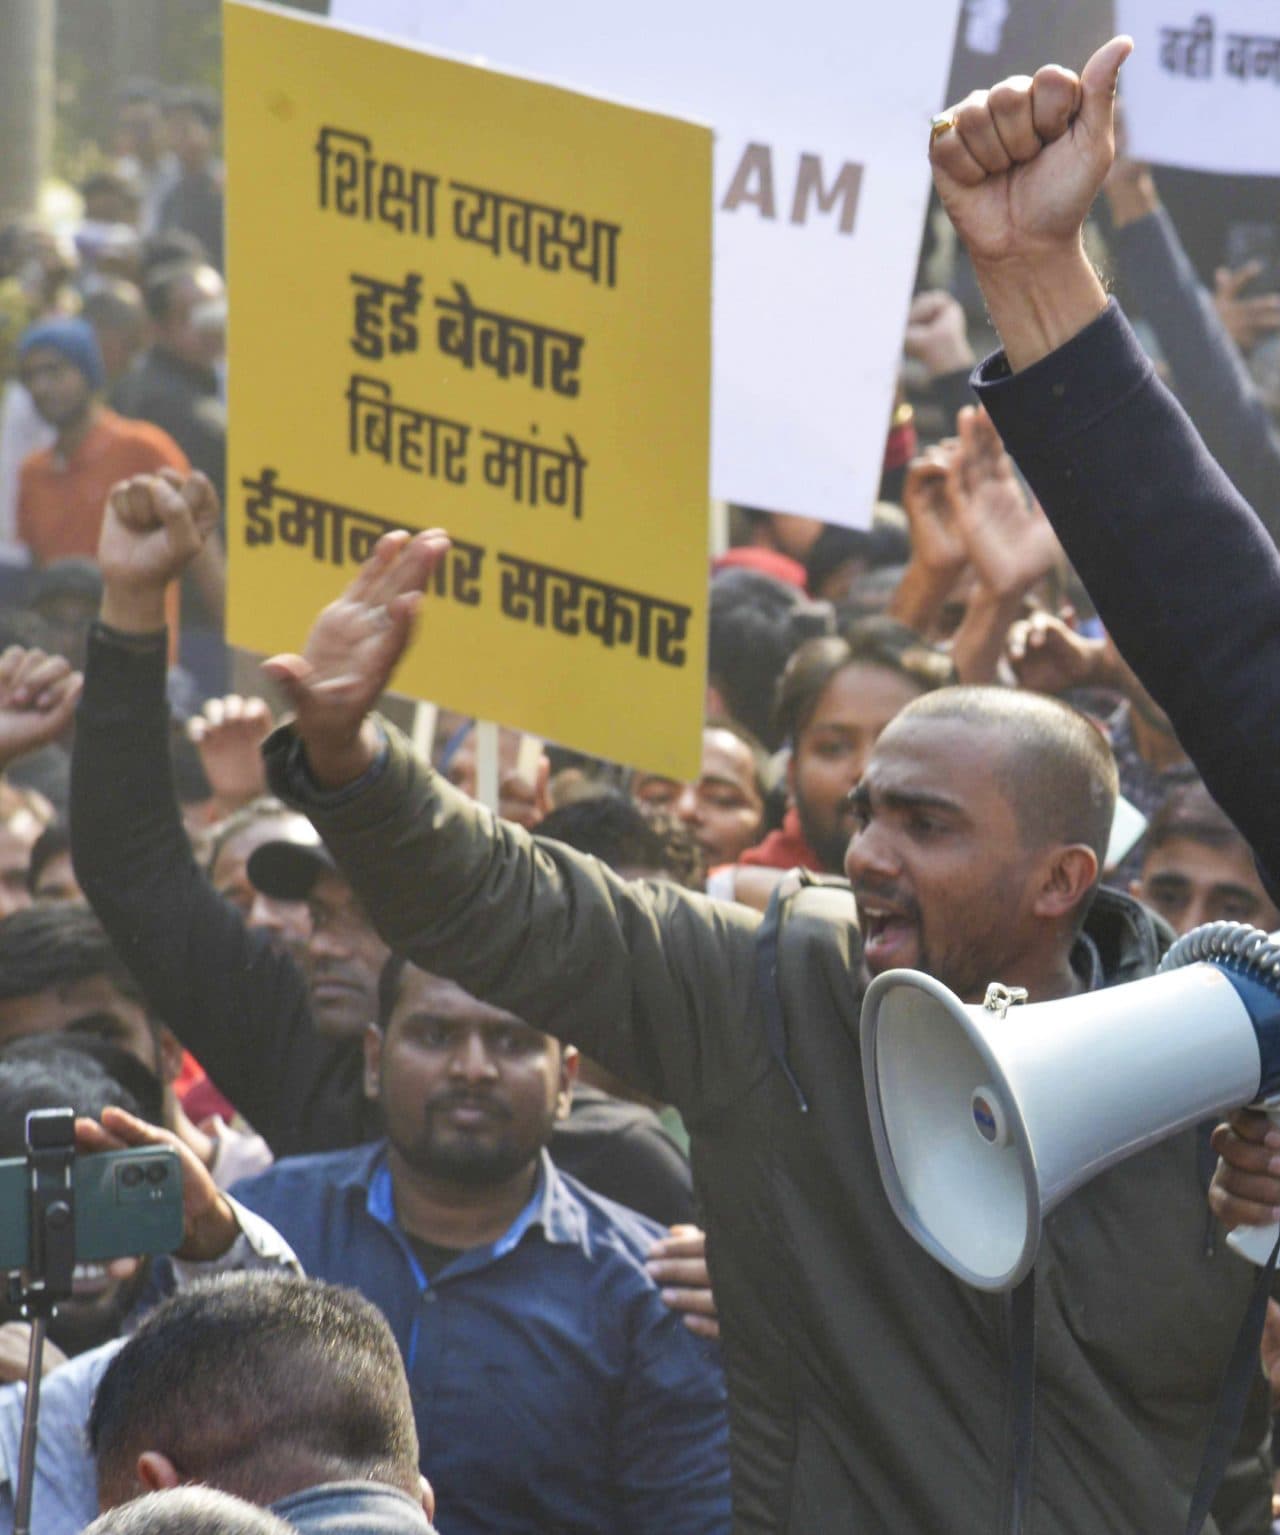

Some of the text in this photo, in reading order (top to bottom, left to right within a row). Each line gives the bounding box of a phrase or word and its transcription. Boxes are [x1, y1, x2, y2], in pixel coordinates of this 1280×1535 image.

[1158, 15, 1214, 79] वही
[314, 126, 622, 289] शिक्षा व्यवस्था
[350, 273, 586, 398] हुई बेकार
[345, 374, 588, 520] बिहार मांगे
[241, 468, 693, 668] ईमानार सरकार
